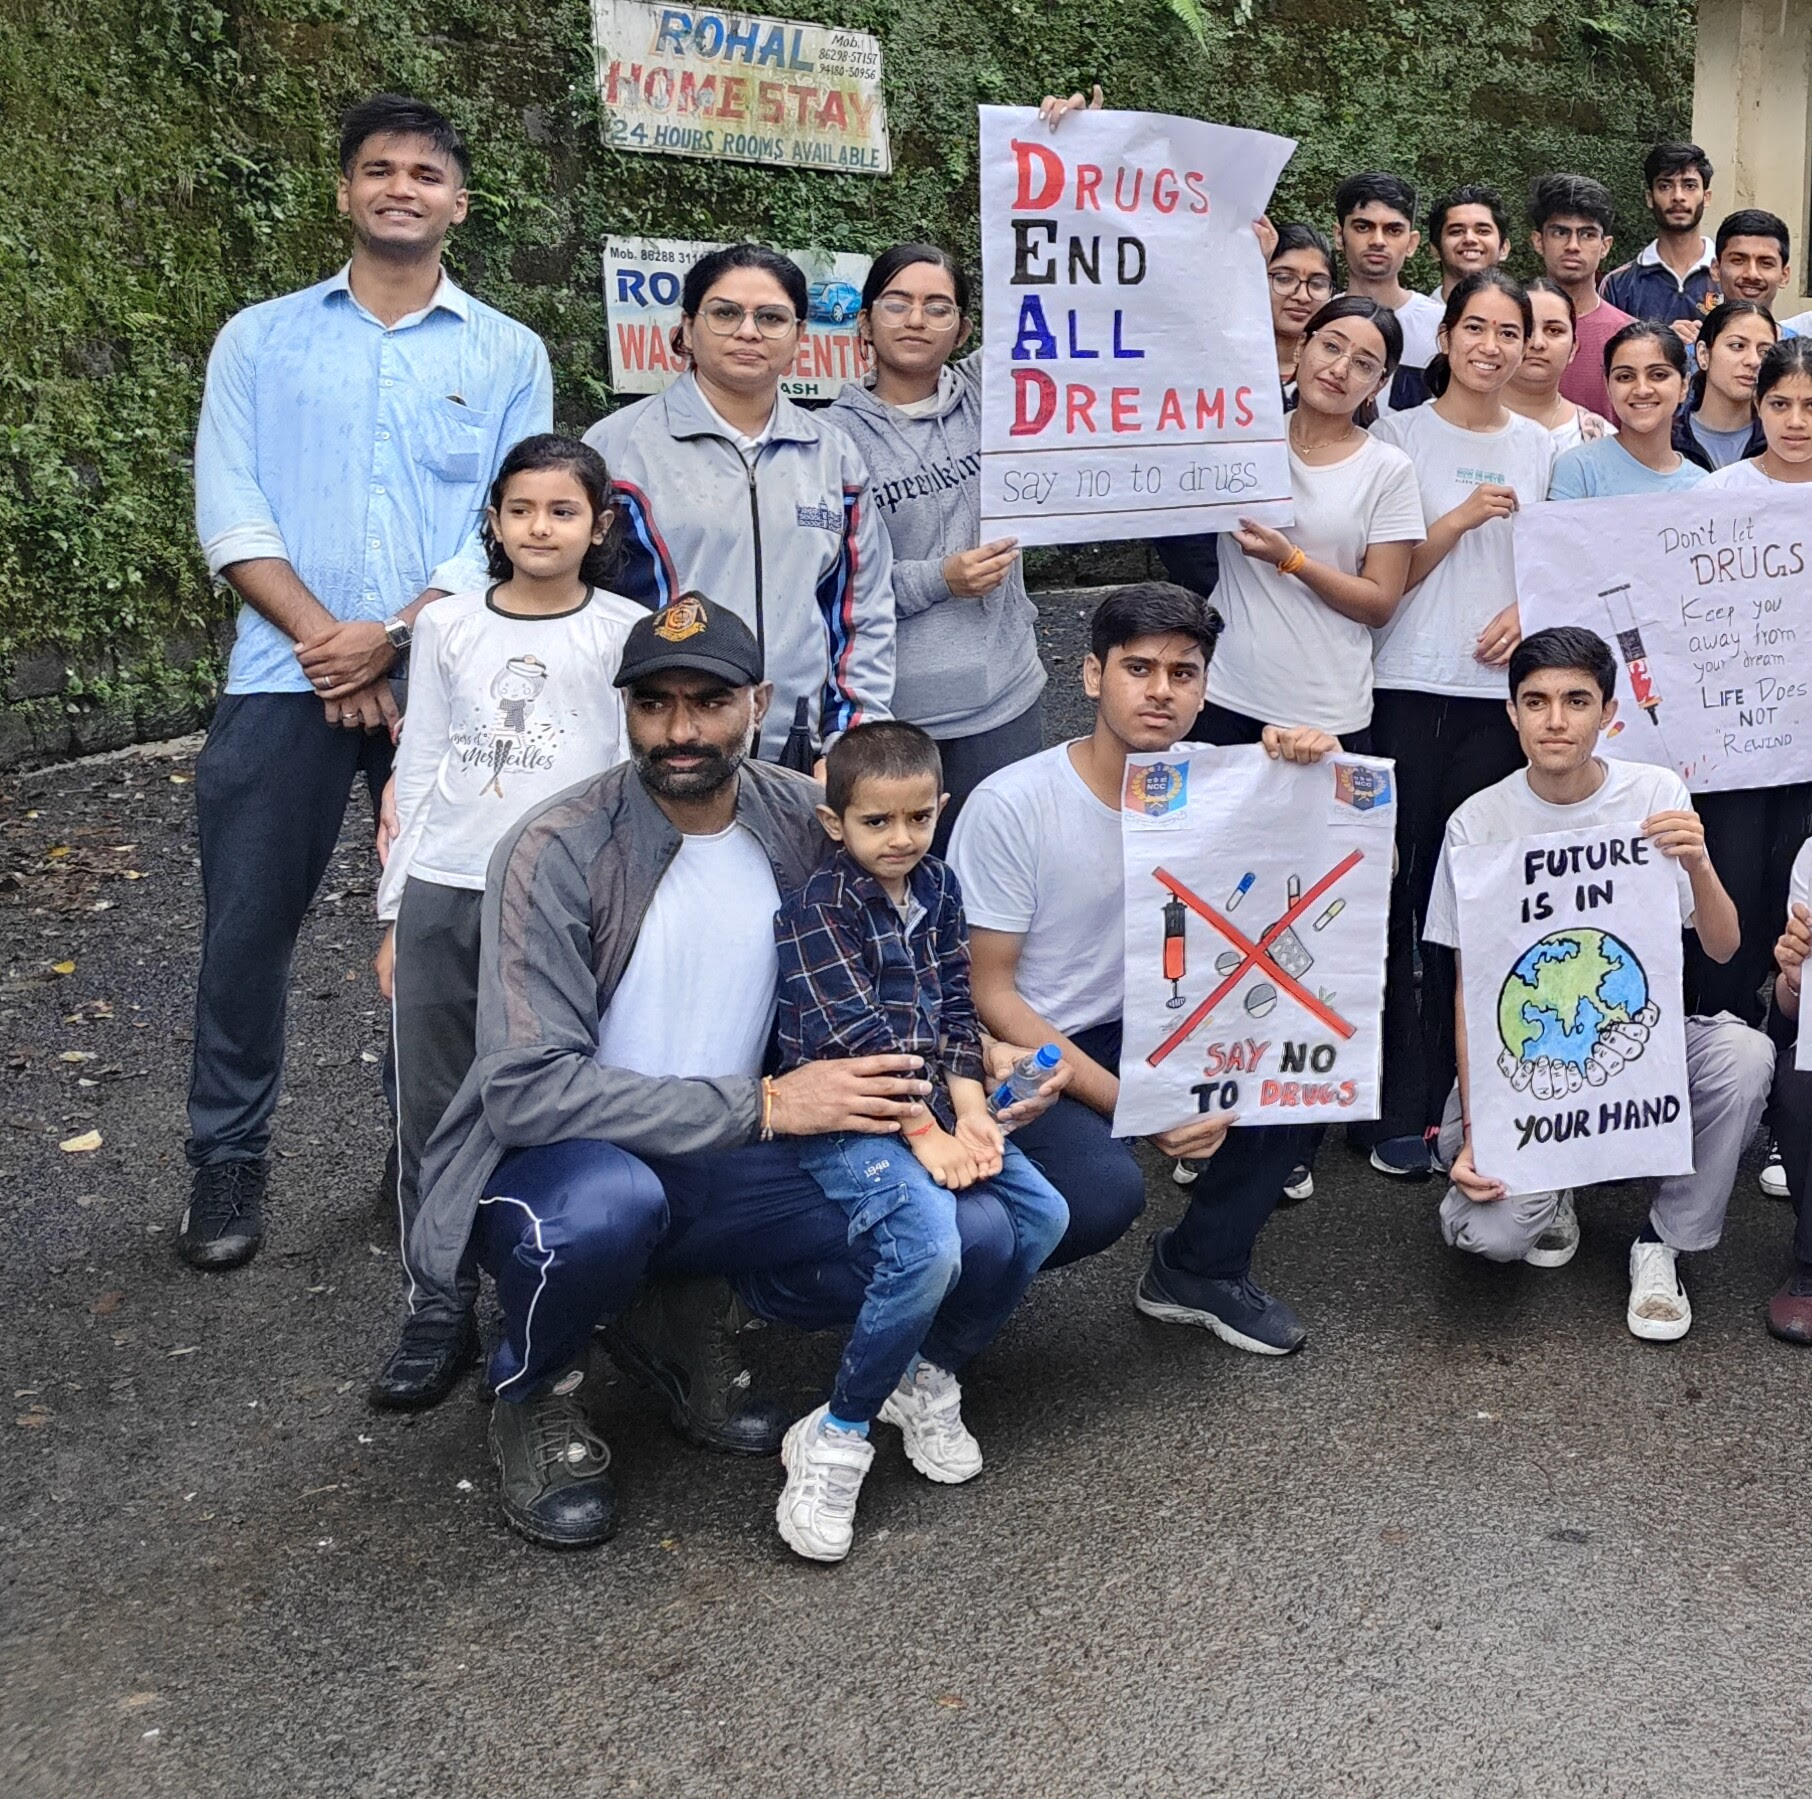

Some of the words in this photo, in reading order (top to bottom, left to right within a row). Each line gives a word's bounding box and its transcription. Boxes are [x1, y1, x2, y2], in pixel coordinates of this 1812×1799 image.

[652, 9, 816, 73] ROHAL
[831, 34, 859, 48] Mob.
[611, 119, 648, 142] 24
[654, 125, 713, 150] HOURS
[723, 132, 784, 160] ROOMS
[792, 141, 881, 168] AVAILABLE
[1010, 138, 1210, 214] DRUGS
[641, 249, 675, 263] 86288
[679, 252, 701, 265] 311
[1009, 219, 1147, 285] END
[1011, 295, 1145, 360] ALL
[779, 334, 873, 381] ENTR
[780, 382, 819, 396] ASH
[1009, 368, 1255, 437] DREAMS
[1003, 469, 1057, 504] say
[1076, 468, 1111, 498] no
[1132, 463, 1161, 493] to
[1180, 461, 1258, 494] drugs
[1657, 519, 1716, 554] Don't
[1732, 517, 1755, 542] let
[1690, 542, 1805, 585] DRUGS
[1752, 597, 1782, 621] you
[1689, 630, 1741, 658] away
[1754, 623, 1797, 646] from
[1693, 656, 1727, 684] your
[1743, 650, 1785, 669] dream
[1701, 686, 1744, 709] LIFE
[1739, 706, 1778, 727] NOT
[1524, 837, 1650, 885] FUTURE
[1521, 891, 1554, 923] IS
[1575, 880, 1614, 912] IN
[1203, 1039, 1271, 1078] SAY
[1280, 1041, 1337, 1074] NO
[1189, 1079, 1240, 1114] TO
[1258, 1079, 1358, 1108] DRUGS
[1514, 1109, 1591, 1151] YOUR
[1598, 1095, 1681, 1134] HAND
